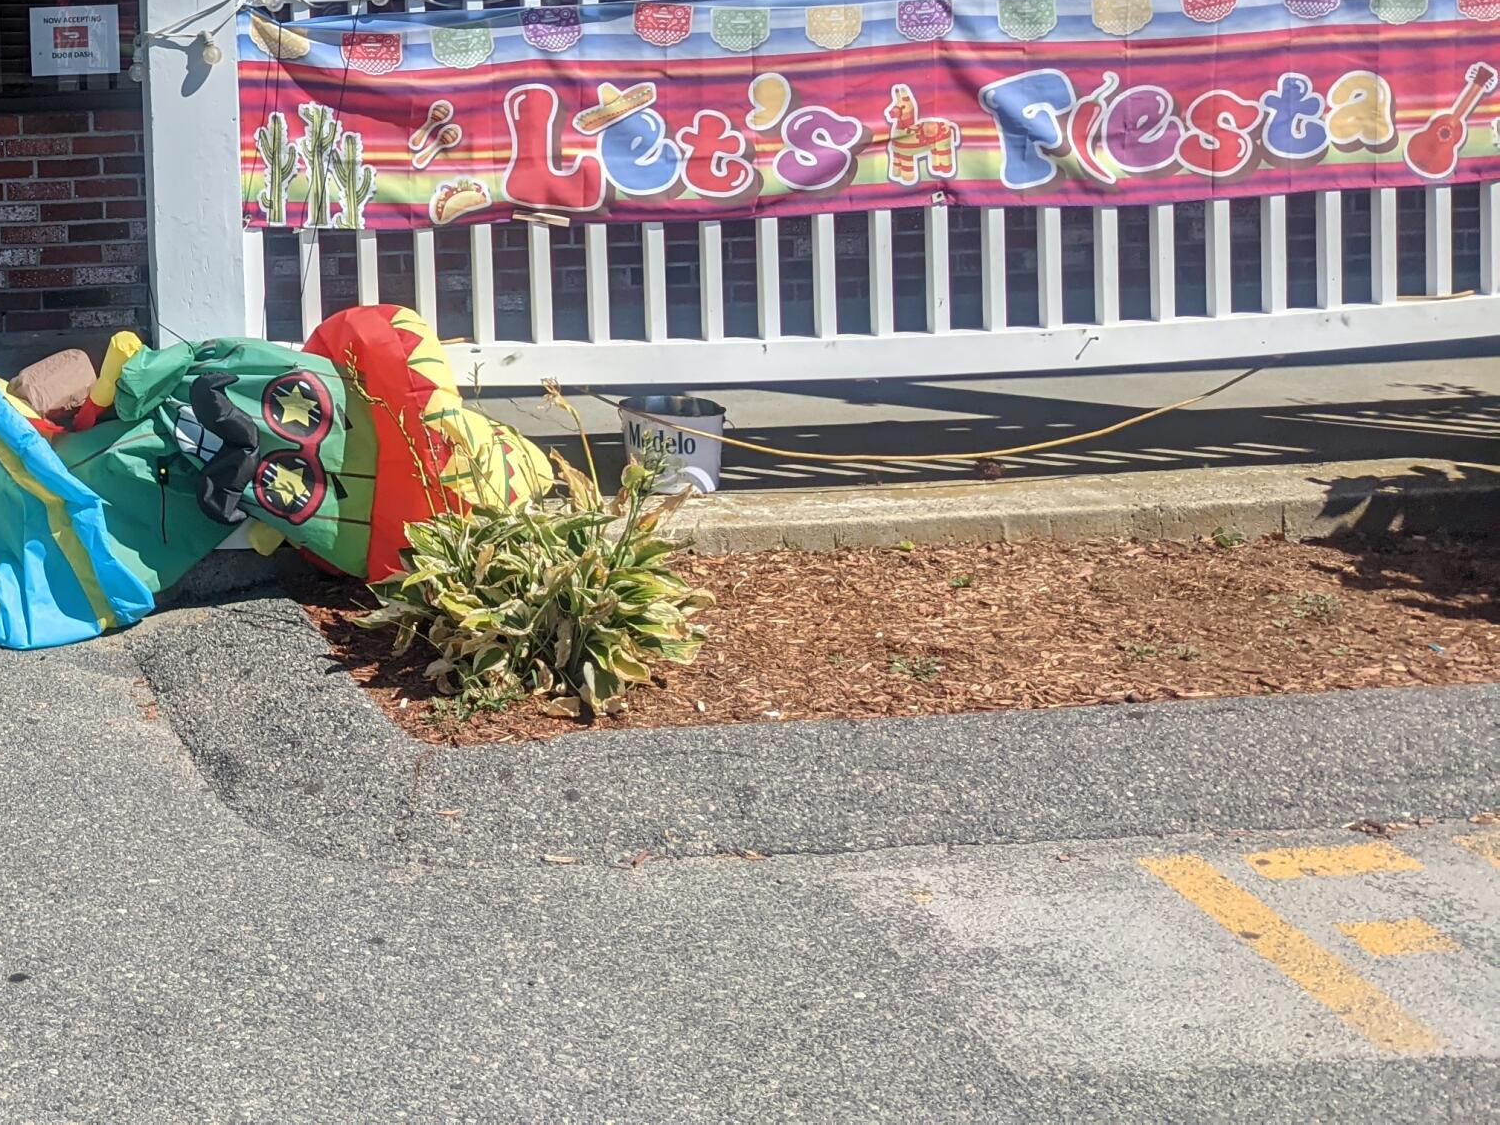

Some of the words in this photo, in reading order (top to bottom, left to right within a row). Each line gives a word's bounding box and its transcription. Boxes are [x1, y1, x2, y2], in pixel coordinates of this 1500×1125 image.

[63, 15, 102, 23] ACCEPTING
[503, 73, 864, 212] Let's
[978, 68, 1395, 190] Fiesta
[628, 421, 696, 455] Mdelo
